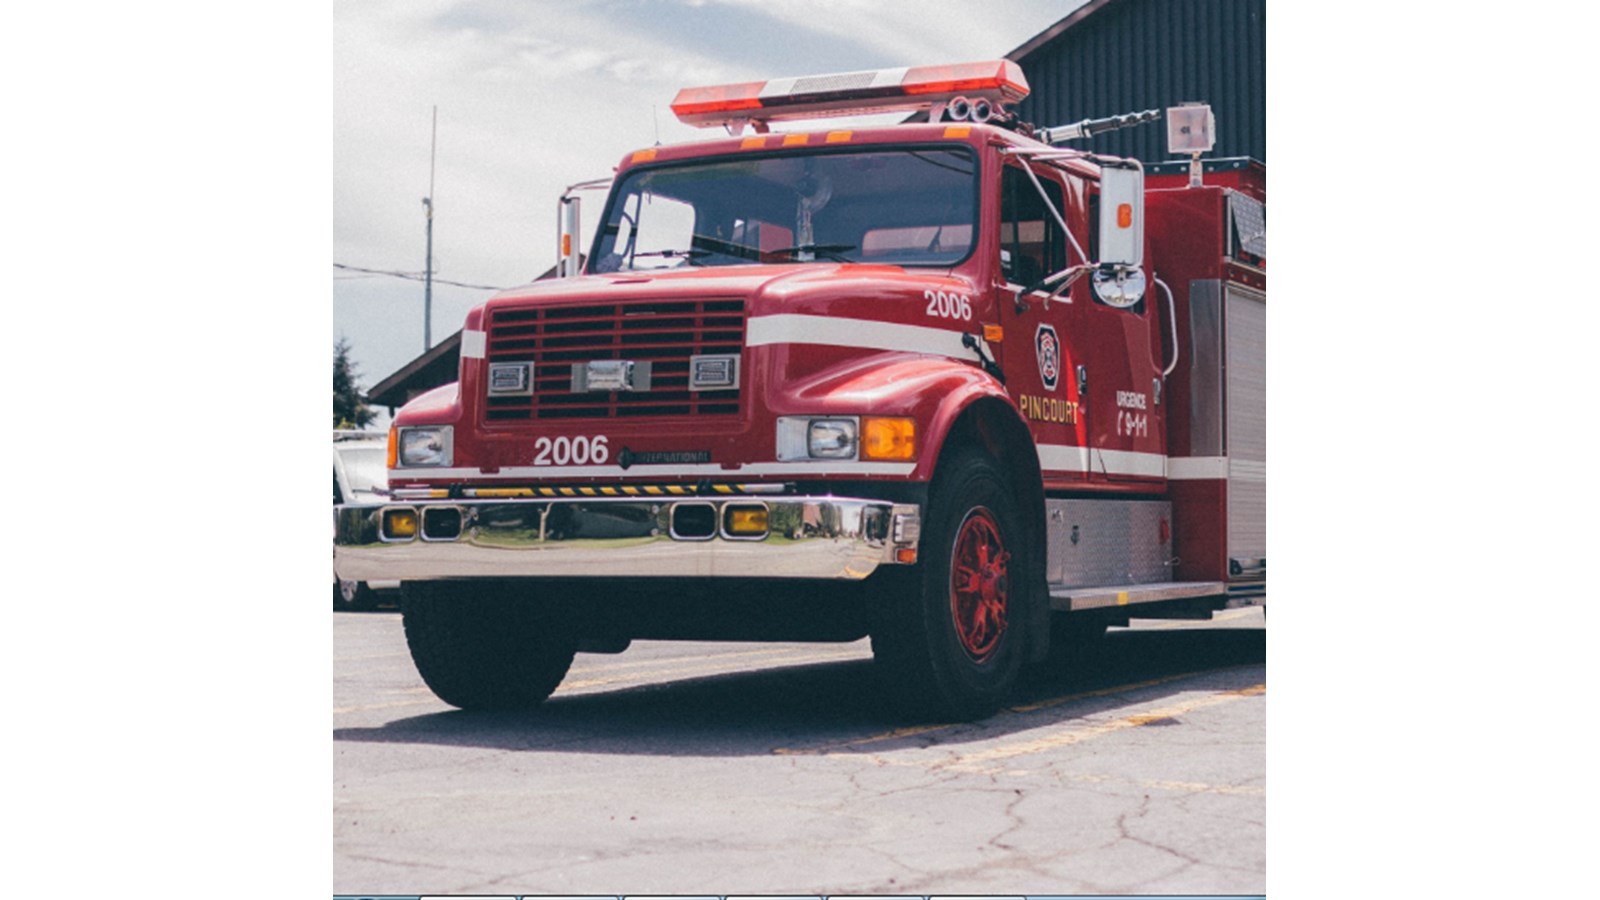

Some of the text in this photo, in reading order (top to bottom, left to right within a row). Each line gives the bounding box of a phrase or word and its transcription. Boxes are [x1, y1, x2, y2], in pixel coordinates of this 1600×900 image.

[924, 290, 972, 321] 2006
[1020, 395, 1079, 424] PINCOURT
[1116, 390, 1146, 409] URGENCE
[534, 435, 609, 465] 2006
